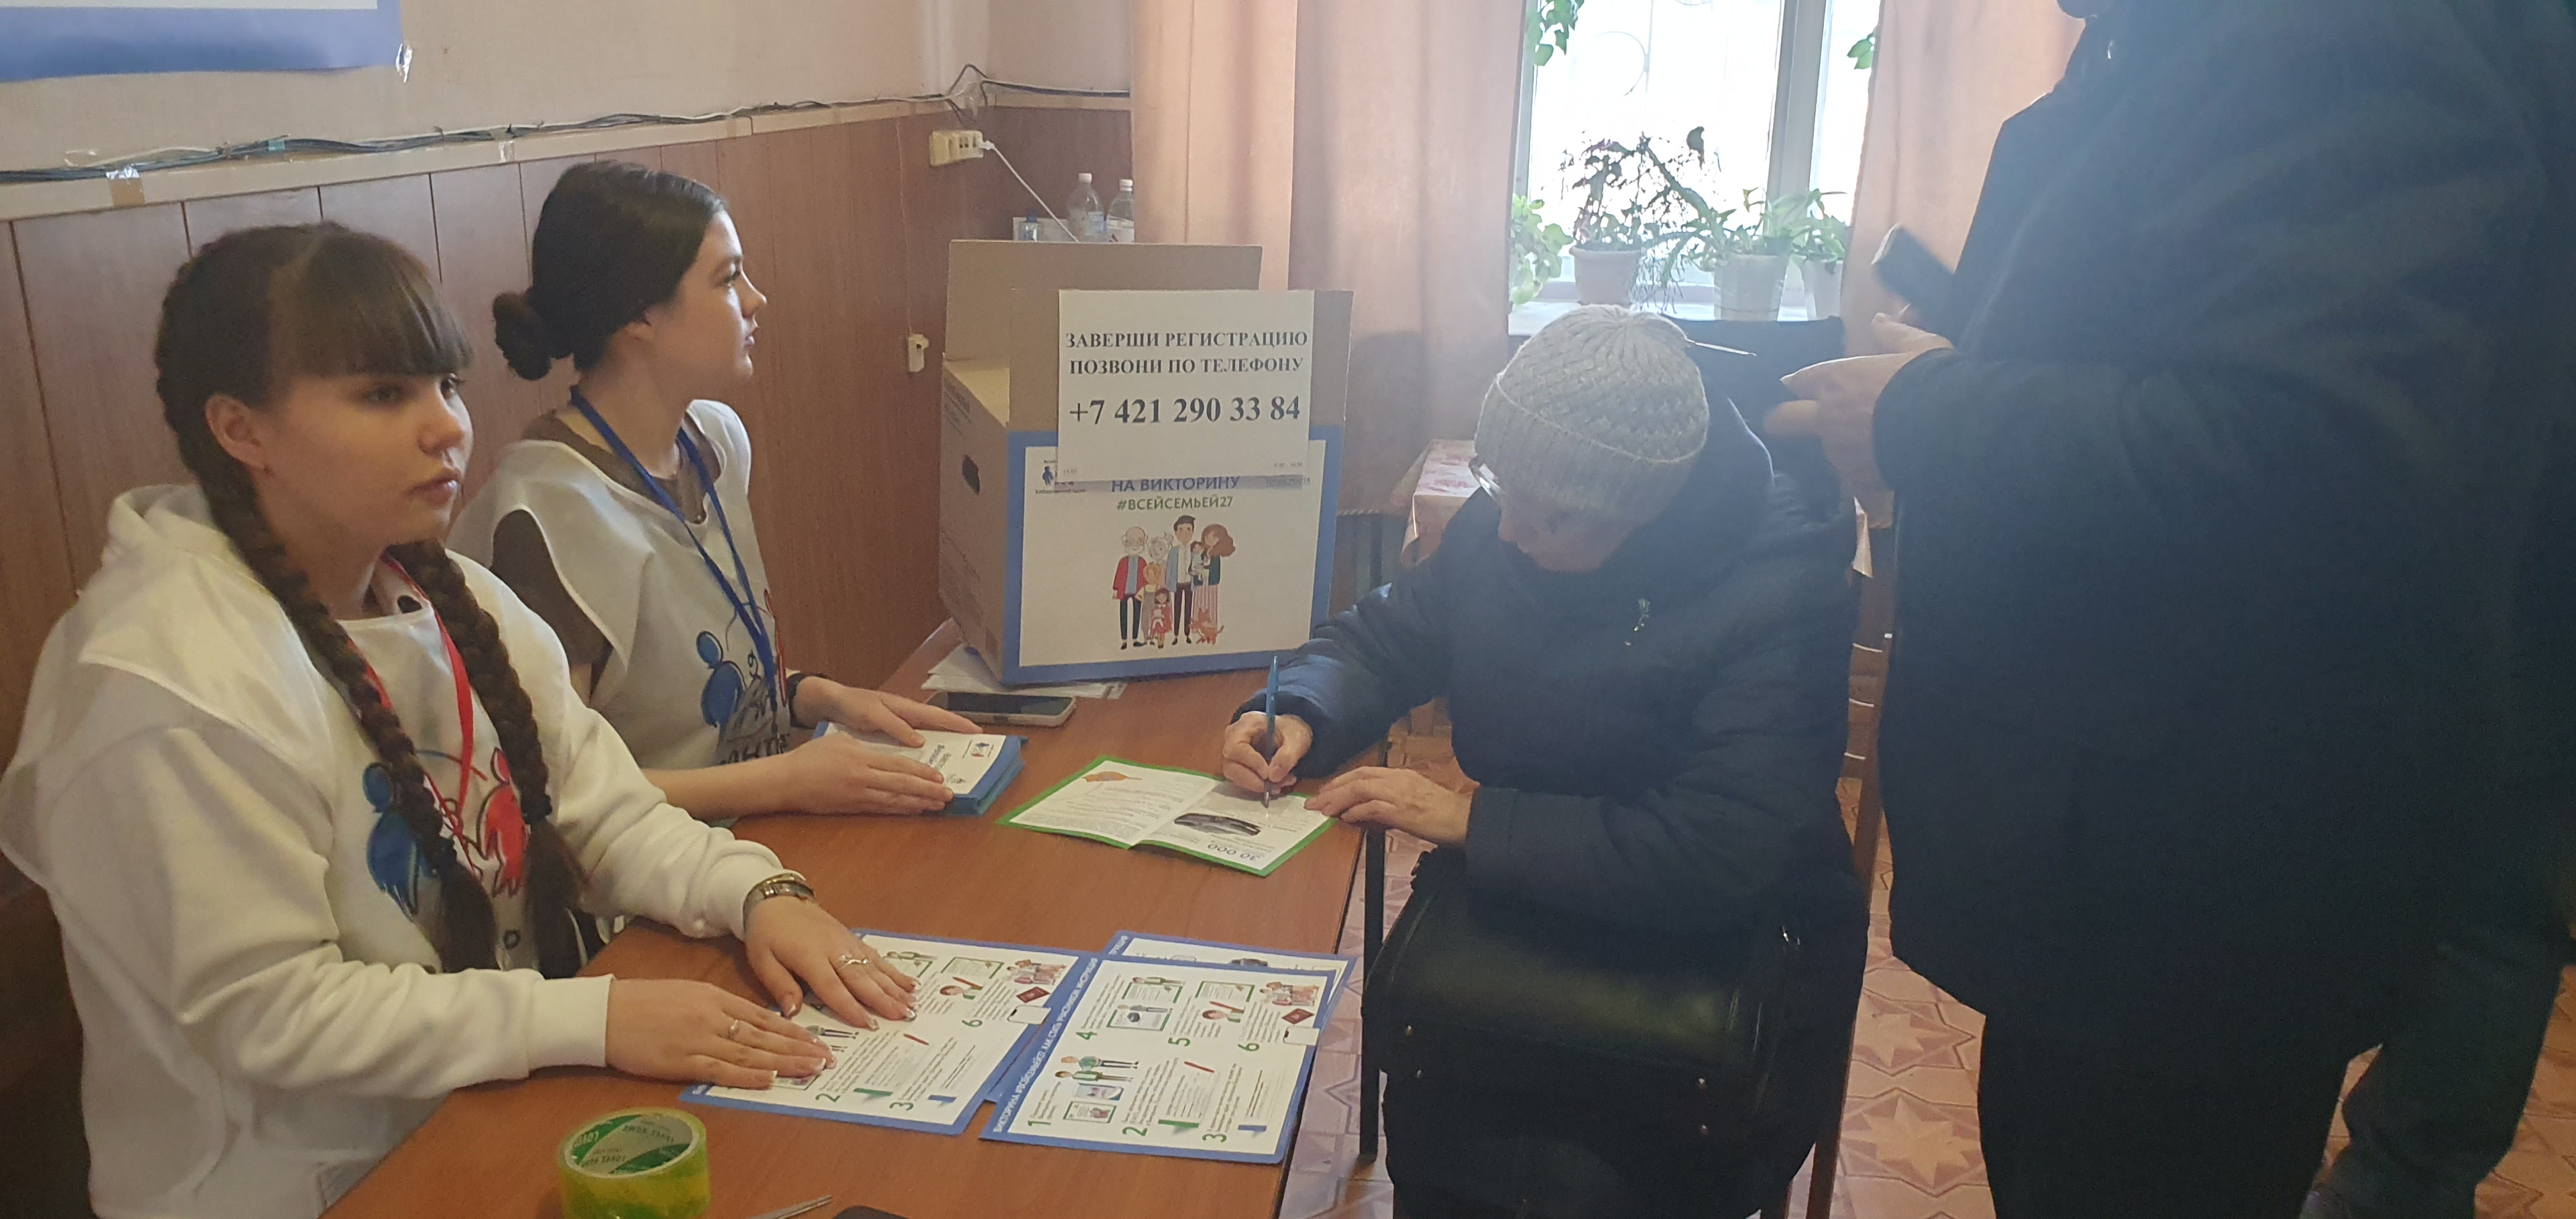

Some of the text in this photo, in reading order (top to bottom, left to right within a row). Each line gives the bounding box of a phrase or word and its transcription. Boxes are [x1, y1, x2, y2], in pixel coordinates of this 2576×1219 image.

[1066, 332, 1308, 348] ЗАВЕРШИ РЕГИСТРАЦИЮ
[1070, 358, 1303, 374] ПОЗВОНИ ПО ТЕЛЕФОНУ
[1070, 395, 1300, 425] +7 421 290 33 84
[1112, 476, 1241, 493] НА ВИКТОРИНУ
[1117, 494, 1234, 511] #ВСЕЙСЕМЬЕЙ27
[962, 1019, 983, 1027] 6
[1076, 1031, 1098, 1041] 4
[1168, 1037, 1191, 1047] 5
[1238, 1043, 1260, 1052] 6
[815, 1093, 841, 1103] 2
[889, 1101, 914, 1112] 3
[1122, 1126, 1149, 1137] 2
[1202, 1133, 1227, 1143] 3
